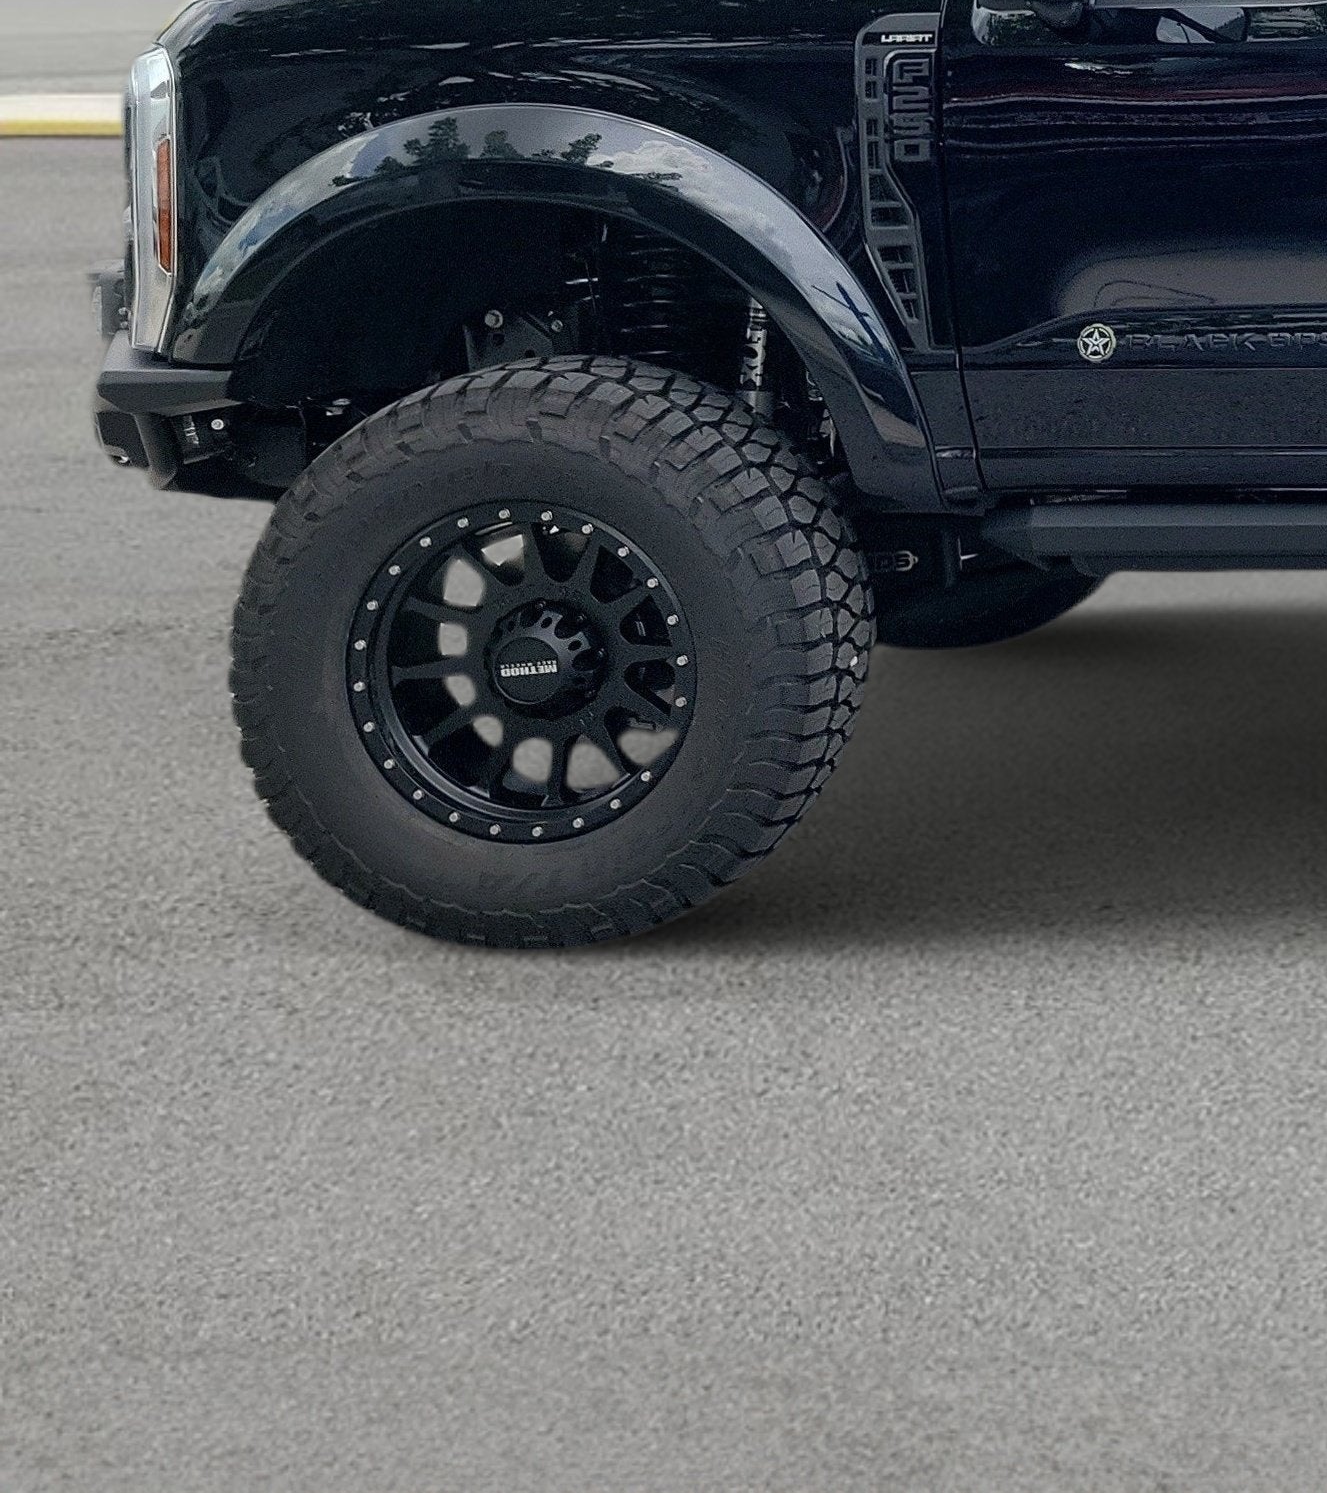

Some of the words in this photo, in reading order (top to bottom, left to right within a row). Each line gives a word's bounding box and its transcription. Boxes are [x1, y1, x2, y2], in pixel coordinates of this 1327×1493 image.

[880, 33, 933, 44] LARIAT
[1125, 333, 1256, 352] BLACK
[500, 664, 558, 677] METHOD
